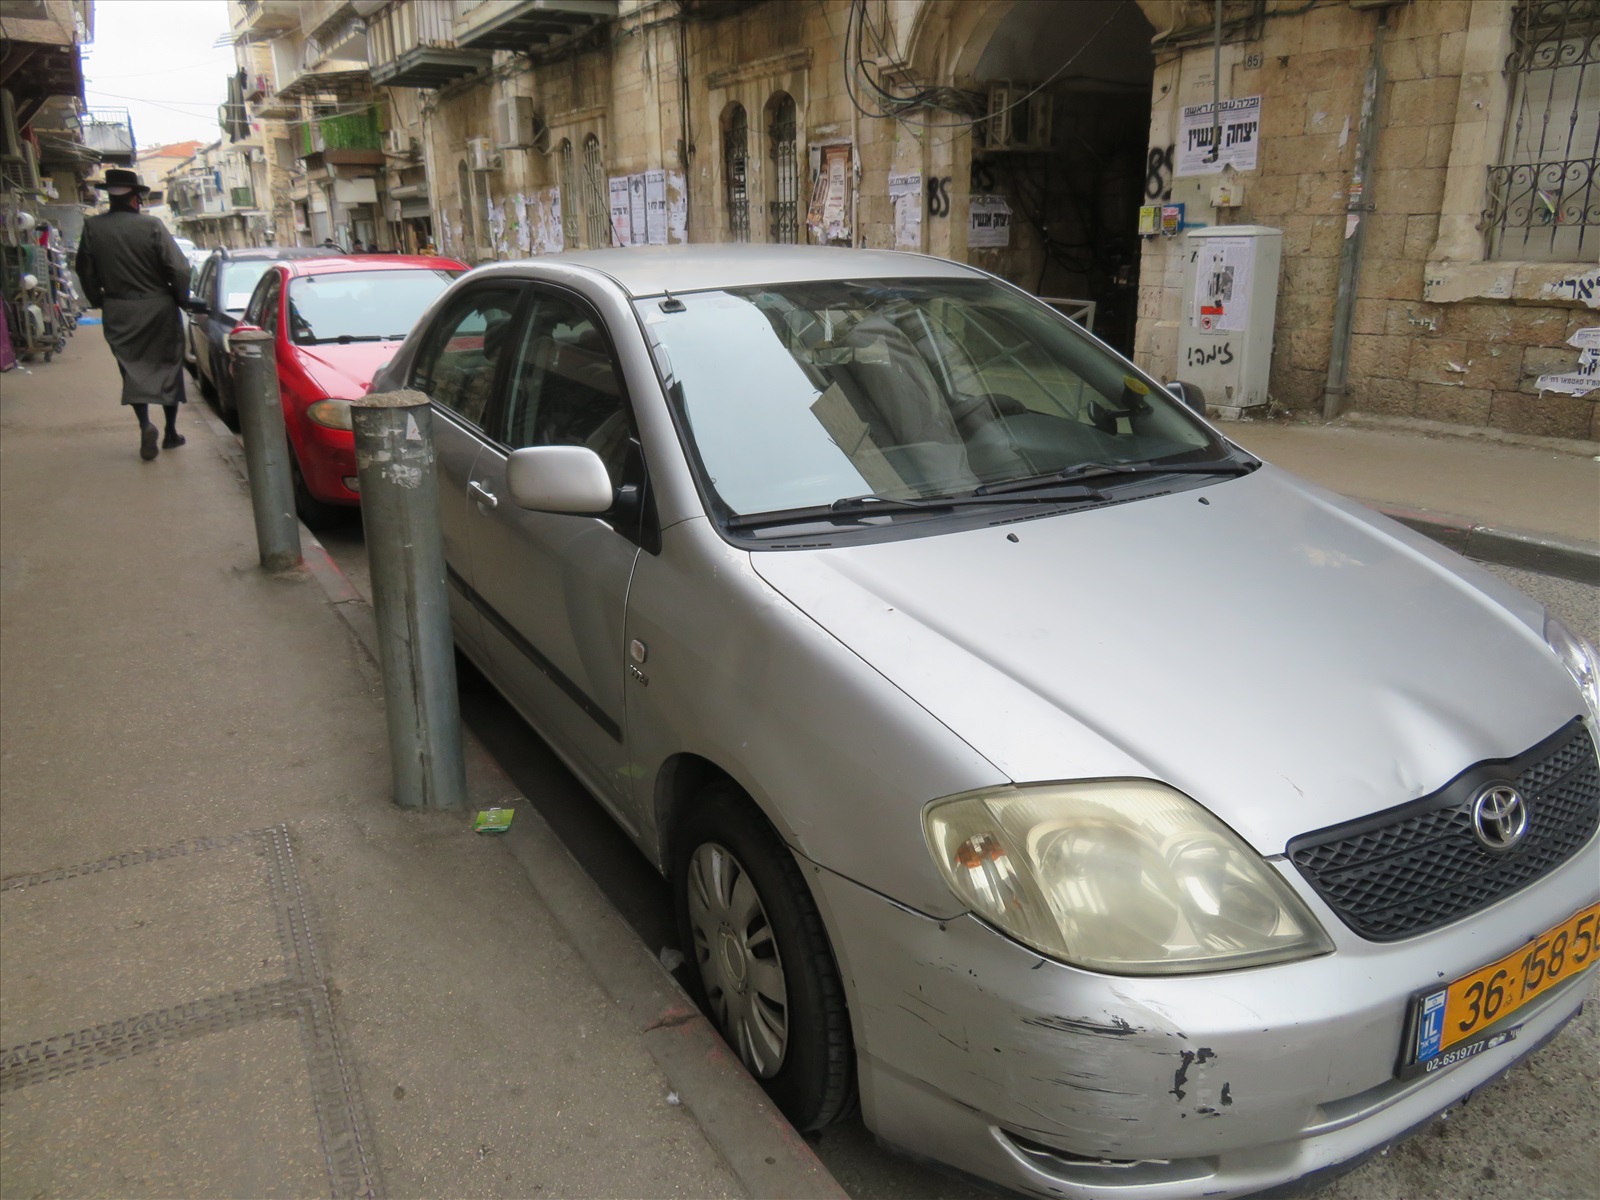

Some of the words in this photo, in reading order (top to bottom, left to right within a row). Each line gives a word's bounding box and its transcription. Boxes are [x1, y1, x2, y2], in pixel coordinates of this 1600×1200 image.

[1246, 55, 1259, 67] 85
[1226, 121, 1257, 147] יצחק
[1423, 1011, 1437, 1040] IL
[1426, 1040, 1485, 1073] 02-6519777
